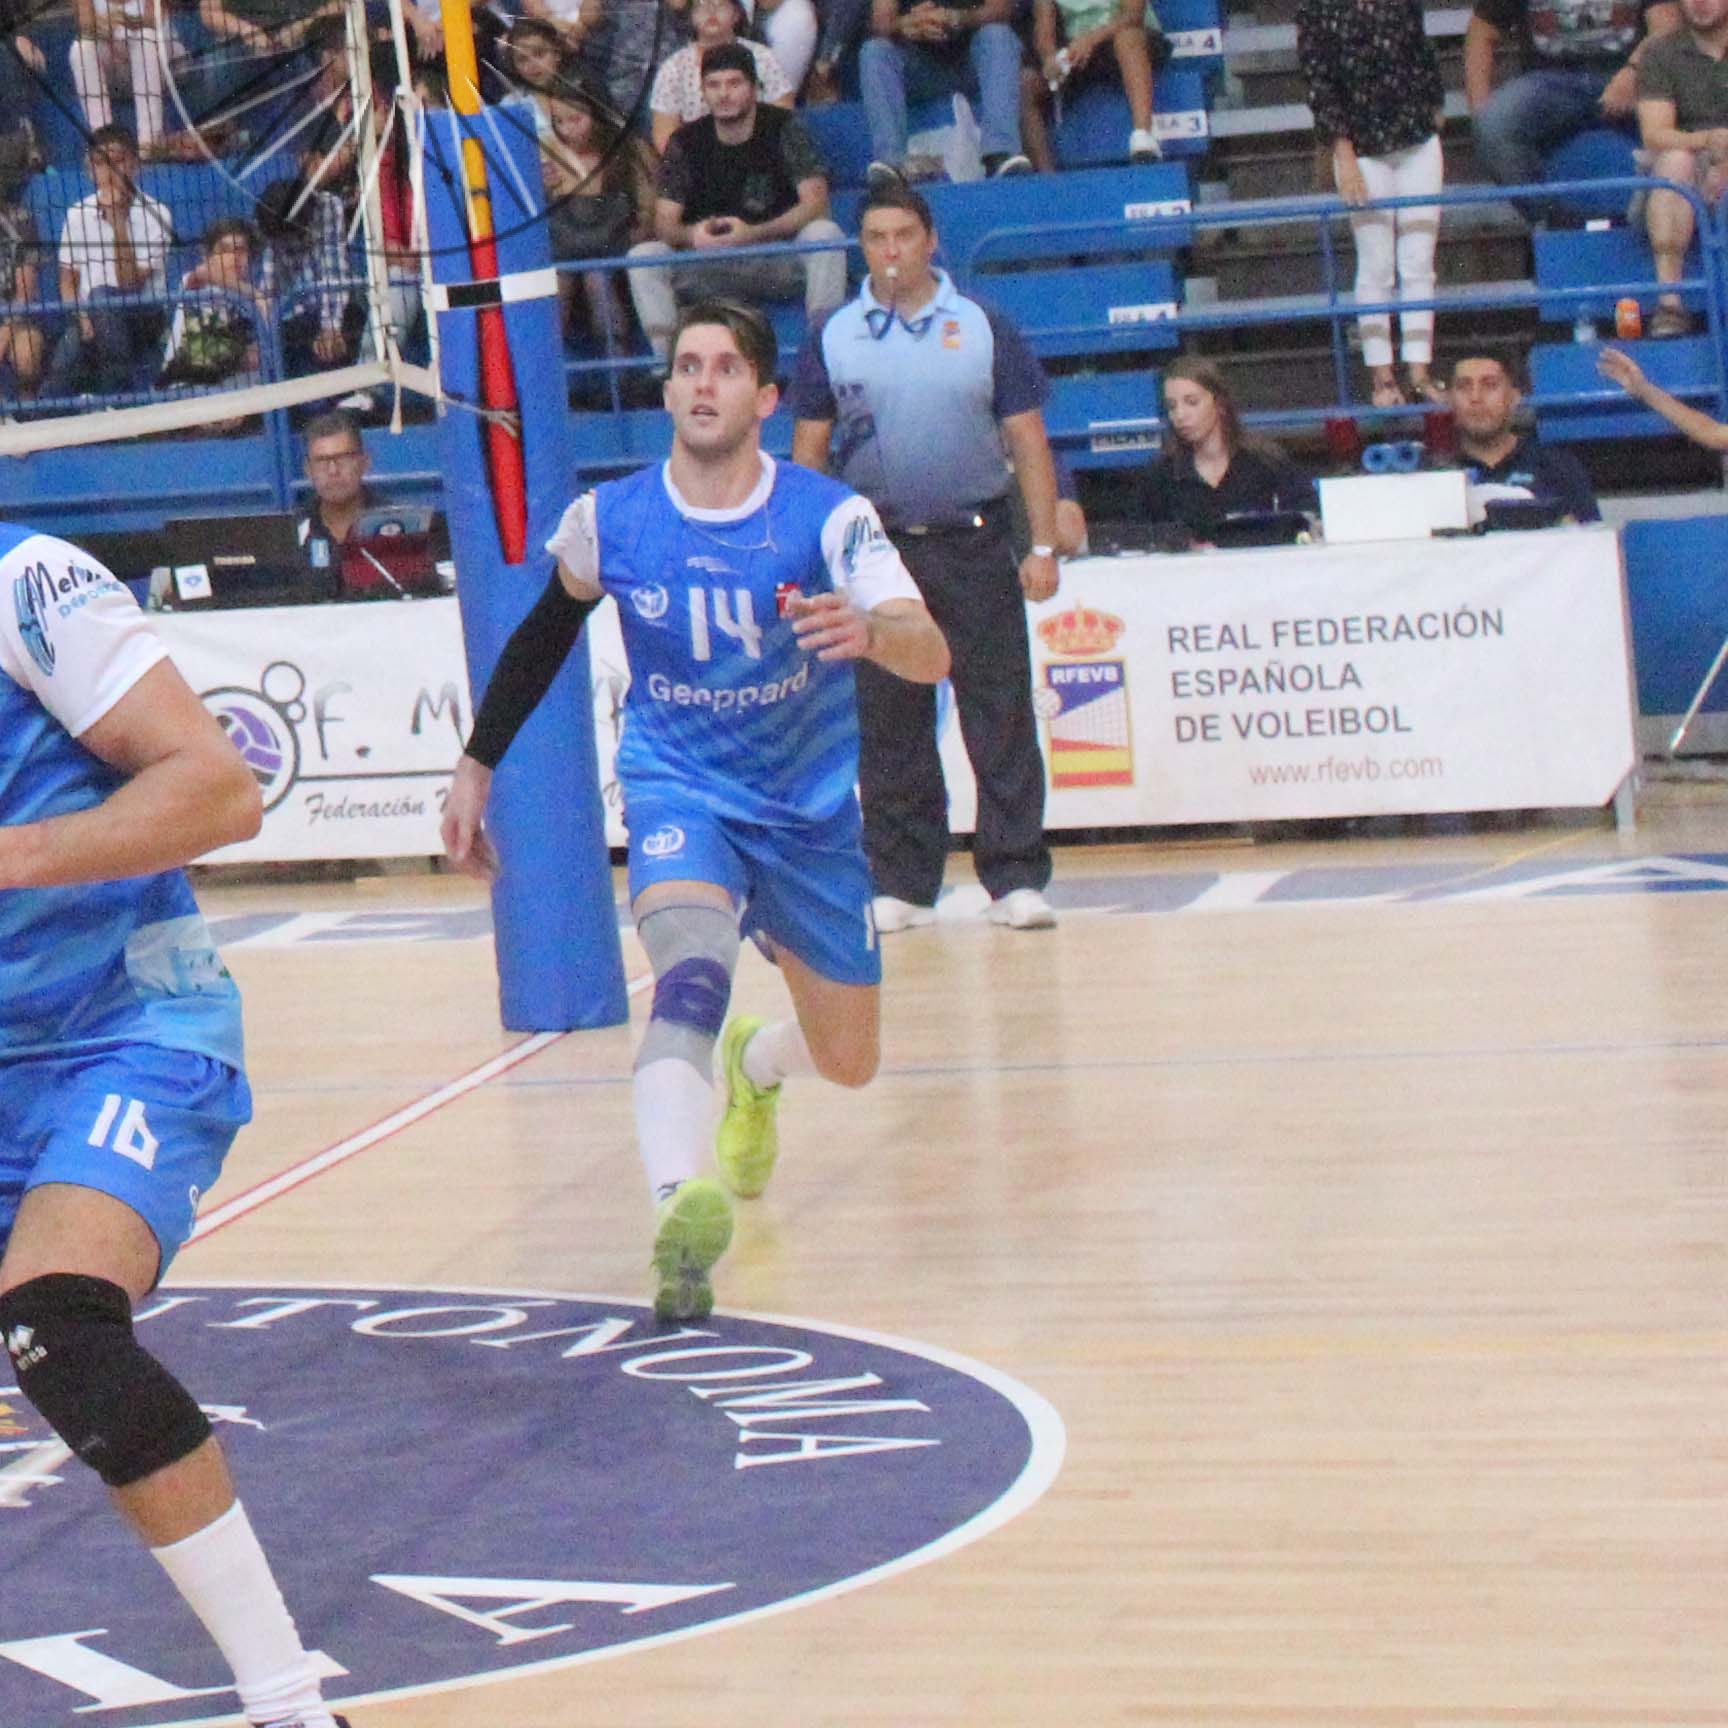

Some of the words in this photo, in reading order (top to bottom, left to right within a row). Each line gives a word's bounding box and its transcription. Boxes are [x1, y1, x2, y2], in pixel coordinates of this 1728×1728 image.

[689, 585, 762, 662] 14
[1168, 620, 1261, 654] REAL
[1272, 604, 1504, 649] FEDERACIÓN
[648, 661, 808, 715] Geoppard
[1049, 666, 1118, 685] RFEVB
[1171, 660, 1362, 698] ESPAÑOLA
[1174, 712, 1223, 745] DE
[1231, 705, 1412, 740] VOLEIBOL
[1249, 753, 1445, 786] www.rfevb.com
[303, 792, 425, 825] Federación
[87, 1093, 161, 1170] 16
